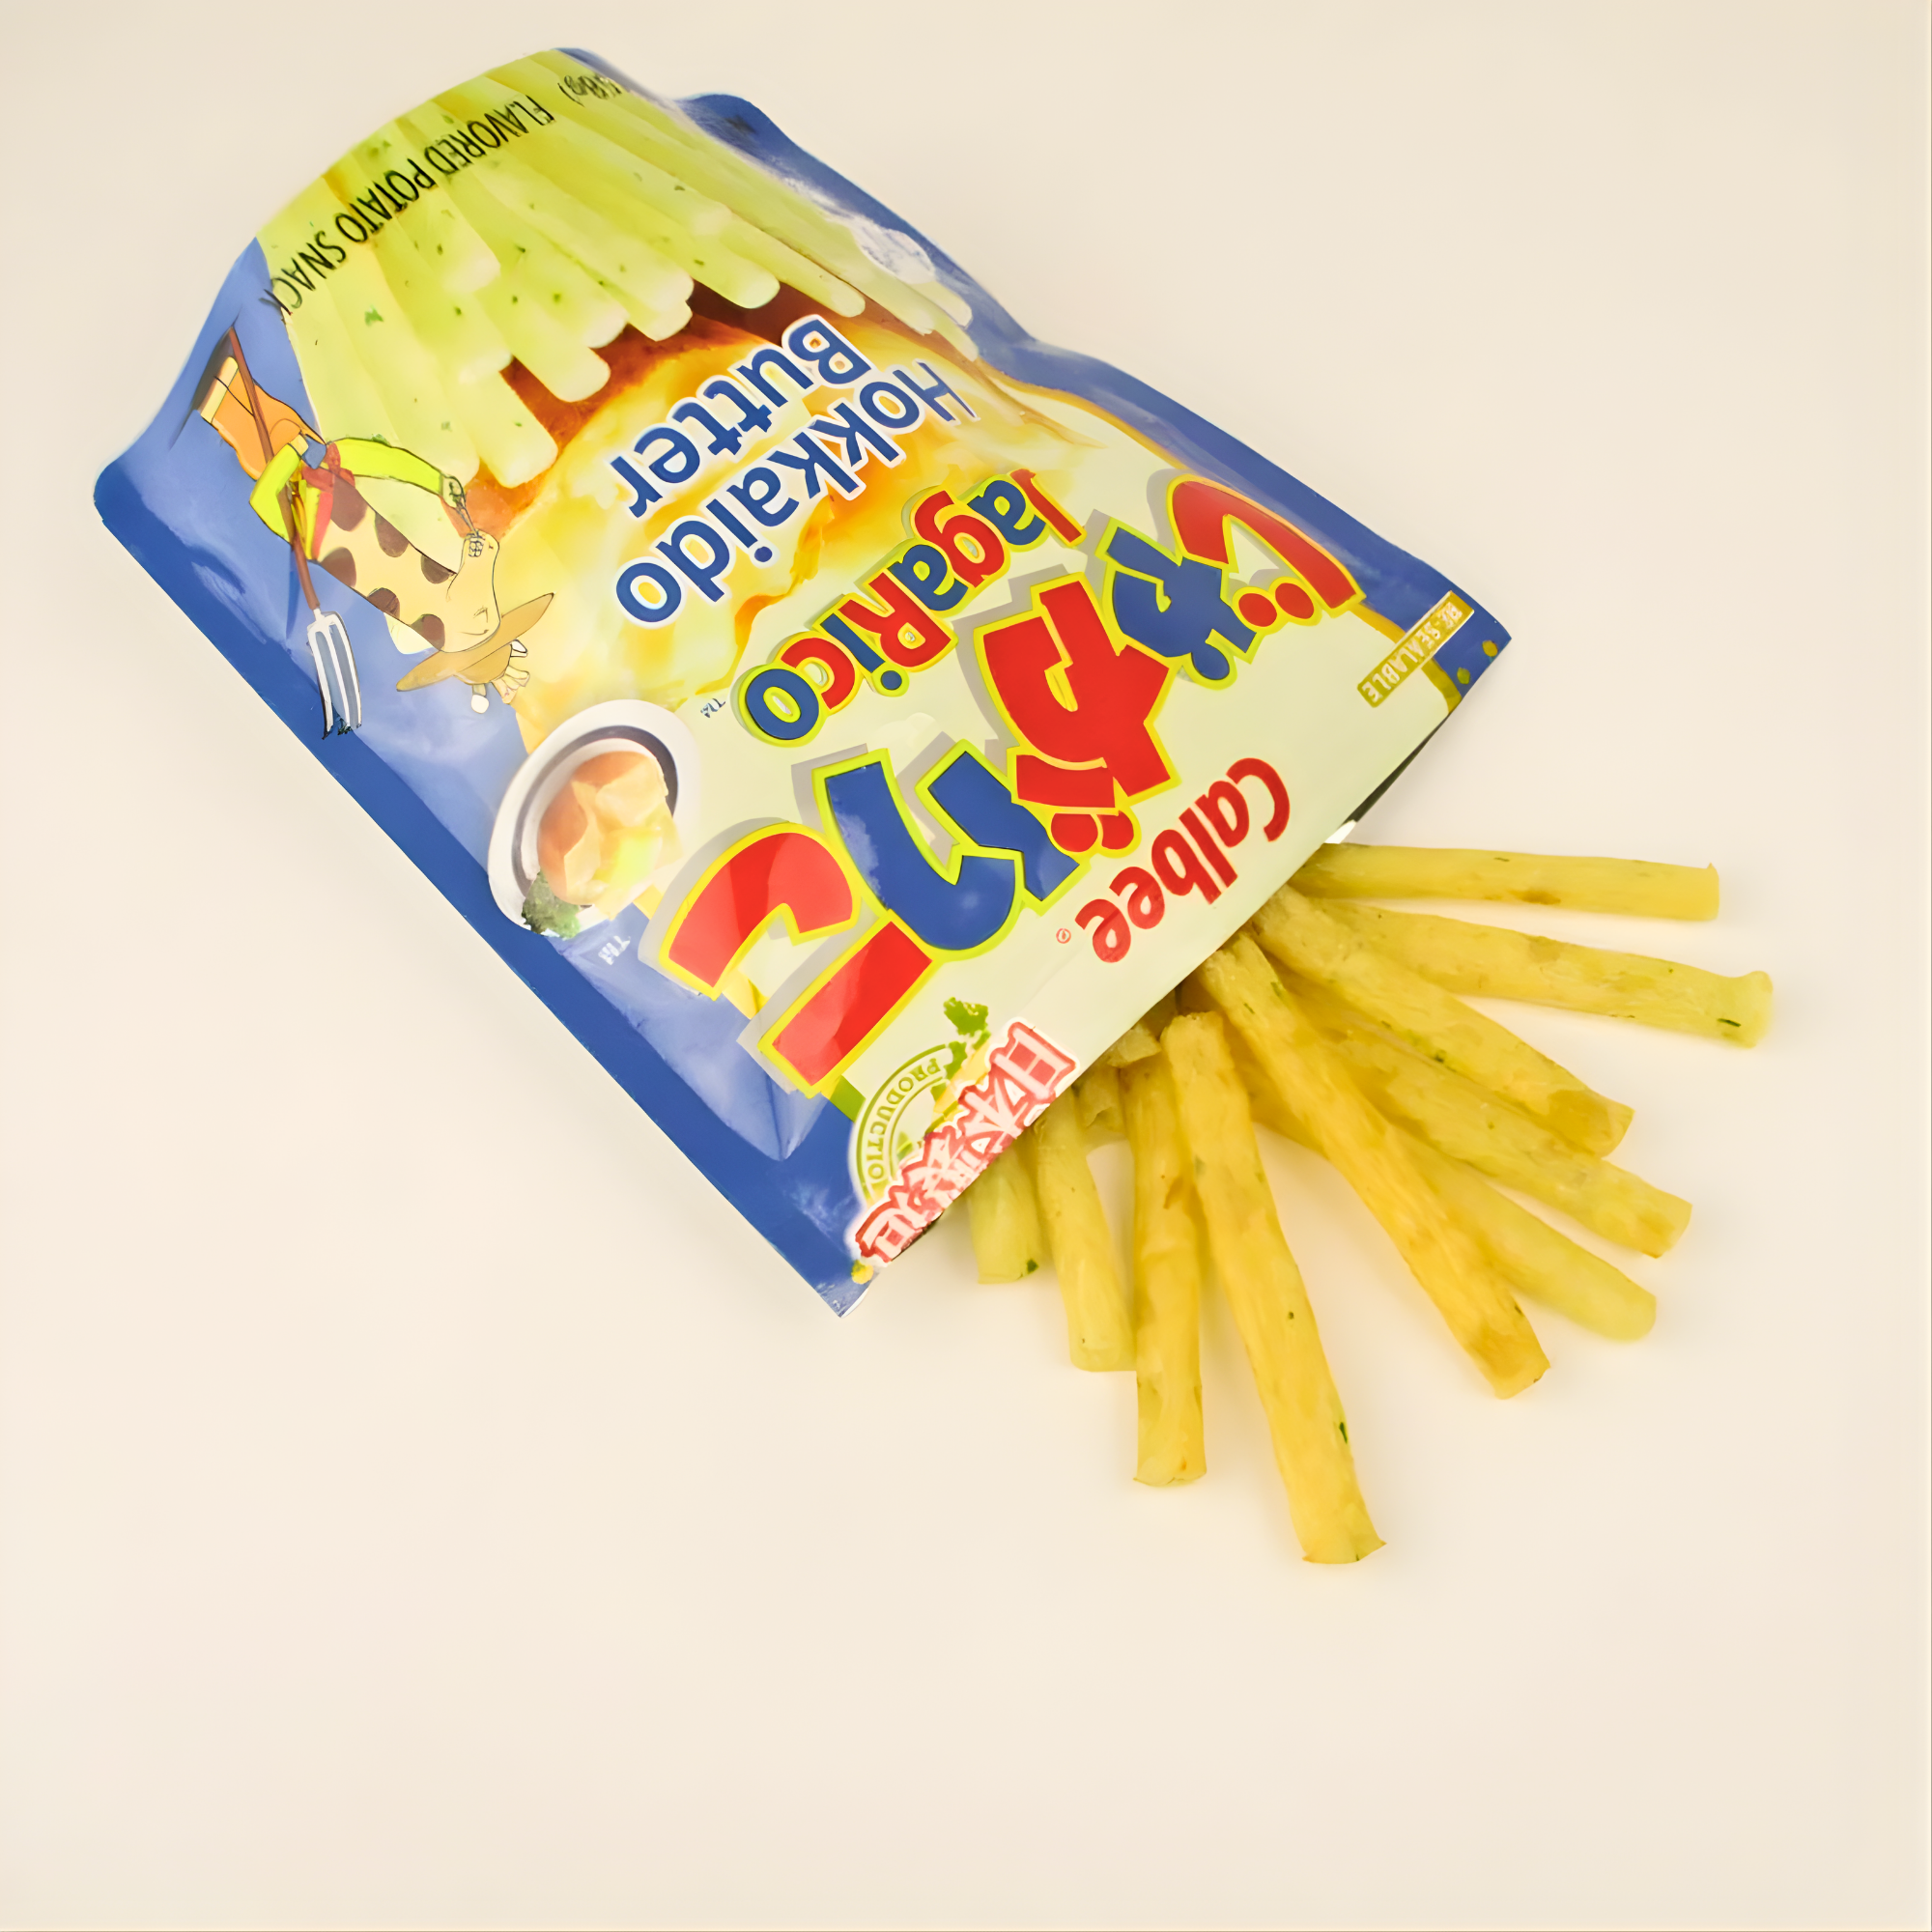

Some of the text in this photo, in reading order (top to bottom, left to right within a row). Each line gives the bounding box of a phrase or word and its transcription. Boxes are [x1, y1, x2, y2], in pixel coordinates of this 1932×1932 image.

[259, 94, 555, 315] FLAVORED POTATO SNACK
[609, 318, 872, 519] Butter
[615, 359, 978, 624] Hokkaido
[741, 468, 1084, 742] JagaRico
[661, 475, 1363, 1095] じゃがりこ
[1074, 756, 1291, 964] Calbee
